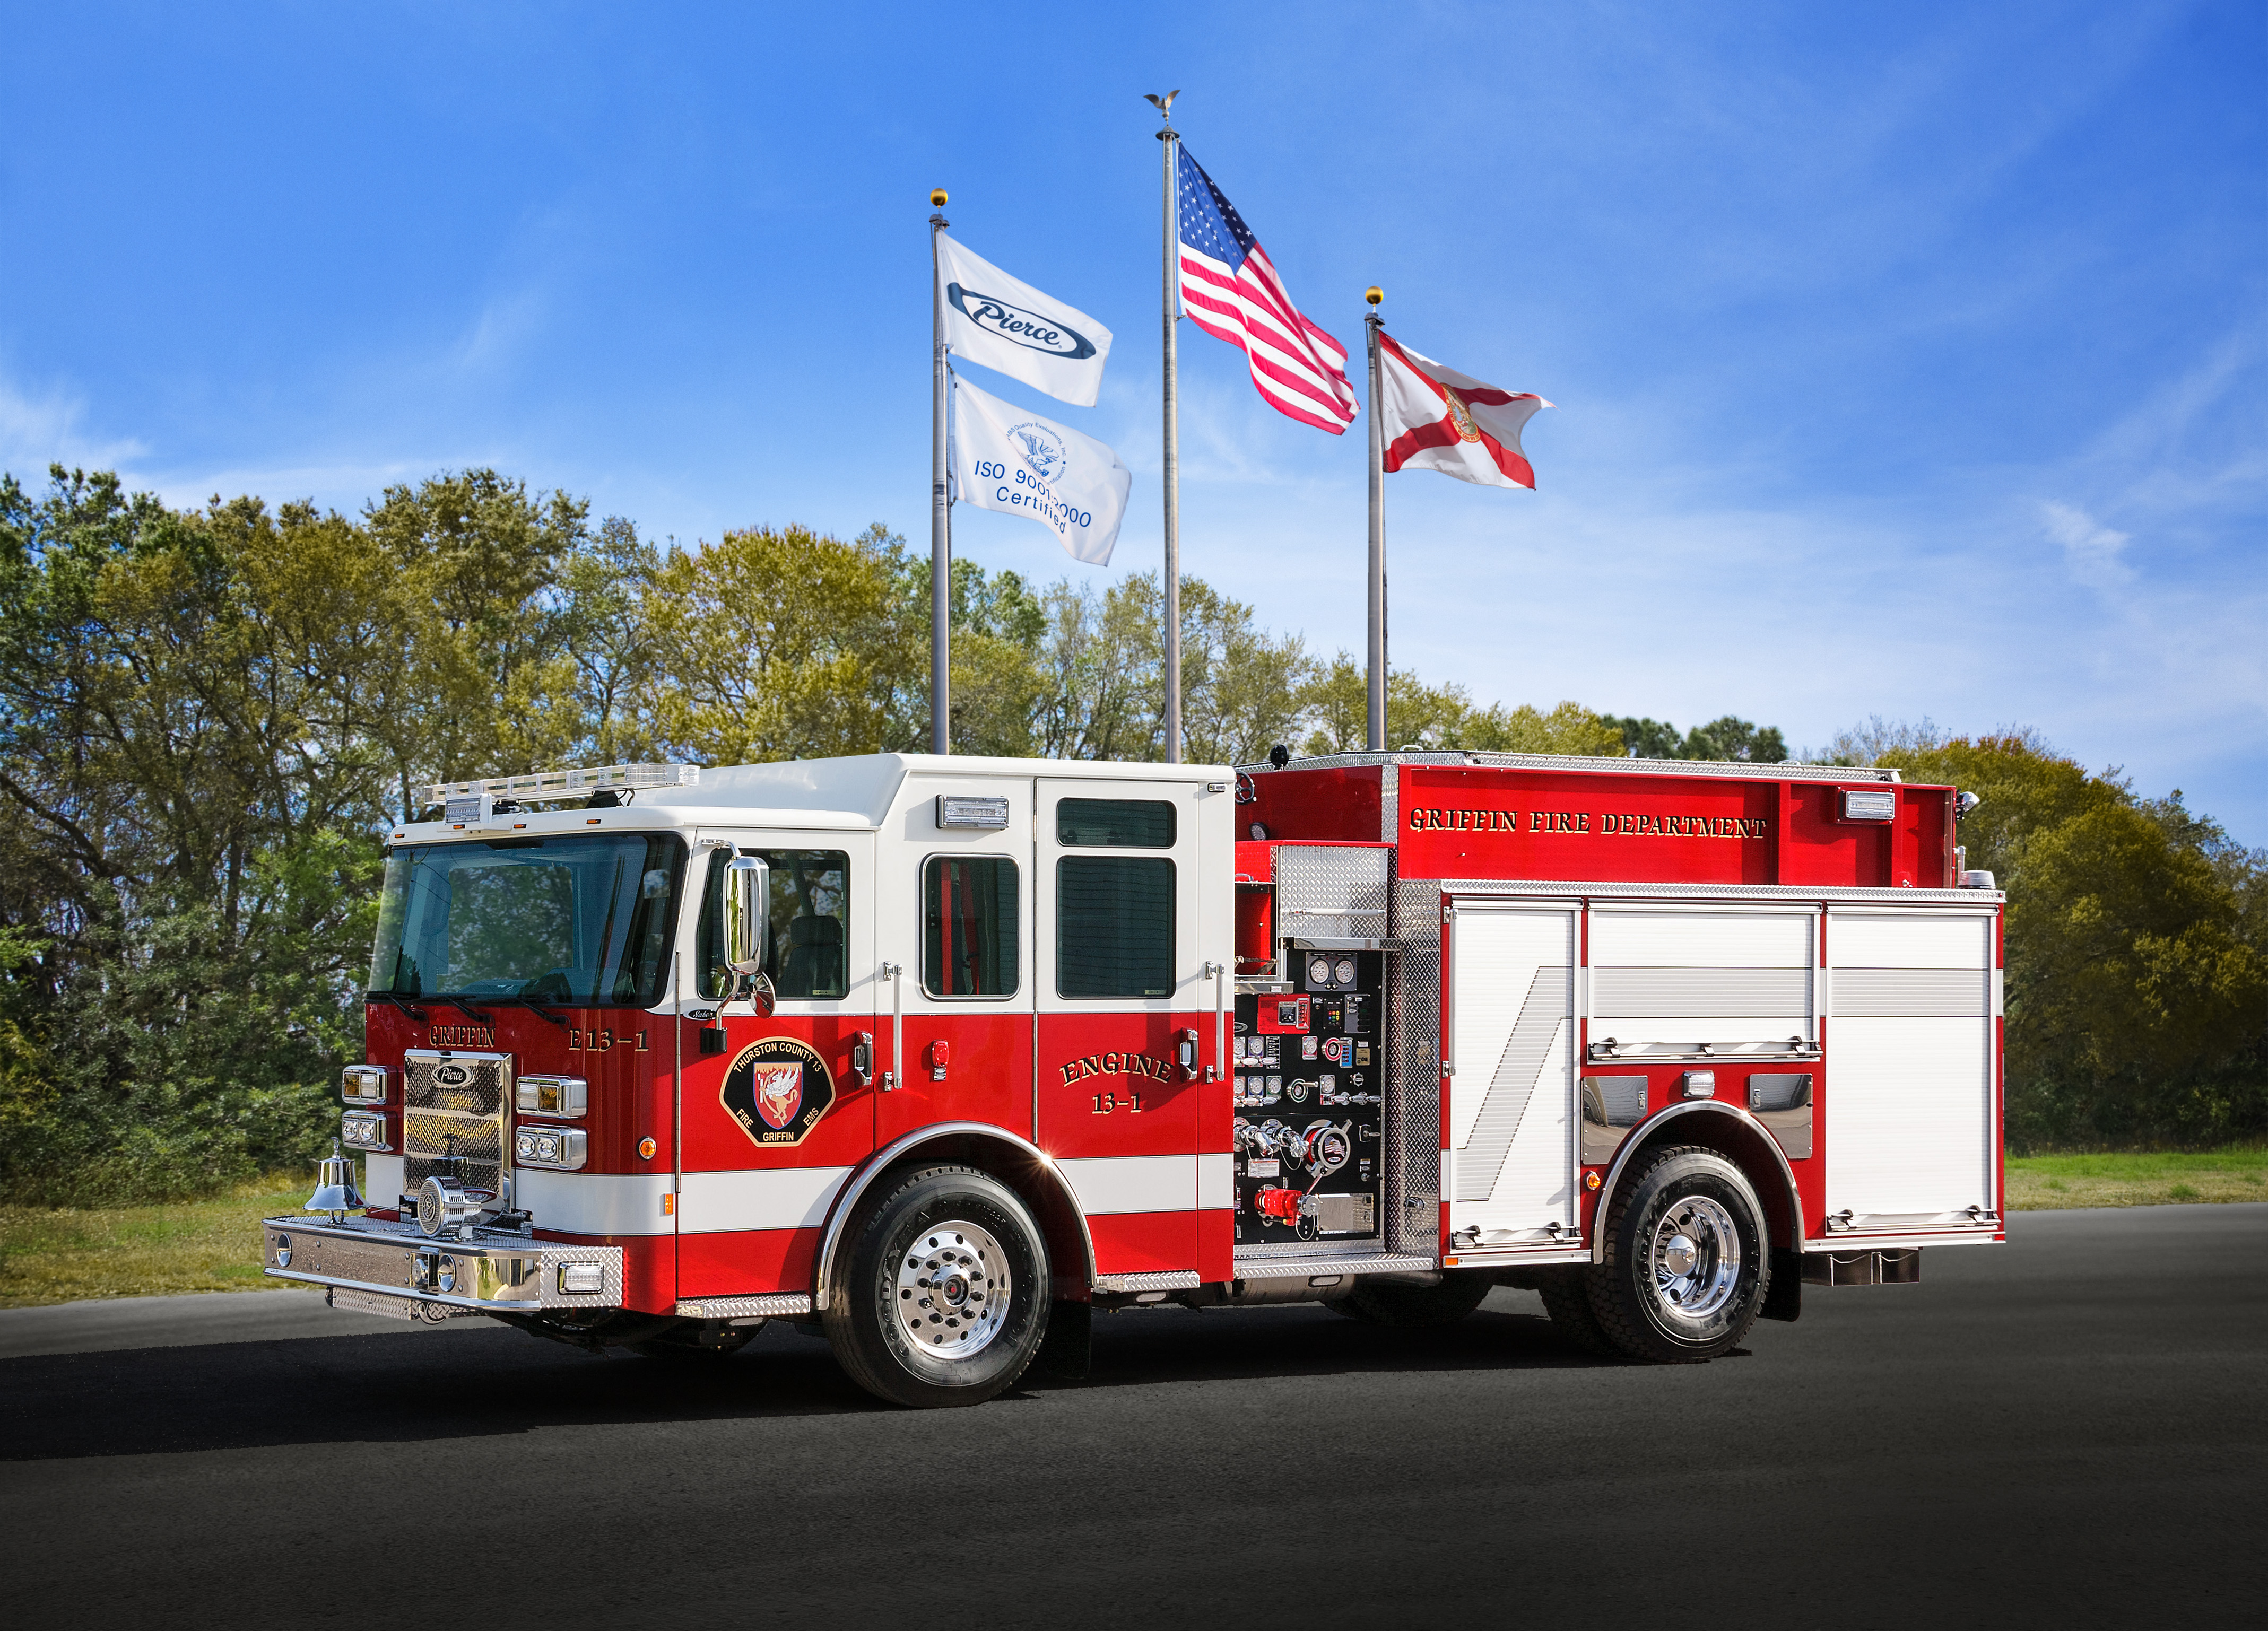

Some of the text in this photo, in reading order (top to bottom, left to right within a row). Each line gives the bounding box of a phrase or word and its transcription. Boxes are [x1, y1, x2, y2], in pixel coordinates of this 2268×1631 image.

[973, 301, 1061, 345] Pierce
[1014, 422, 1033, 430] Quality
[975, 460, 1005, 479] ISO
[996, 486, 1066, 534] Certified
[1410, 808, 1768, 839] GRIFFIN FIRE DEPARTMENT
[429, 1025, 496, 1049] GRIFFIN
[734, 1042, 822, 1073] THURSTON COUNTY 13
[441, 1067, 463, 1081] Pierce
[1059, 1052, 1174, 1087] ENGINE
[1092, 1092, 1142, 1114] 13-1
[736, 1109, 754, 1129] FIRE
[803, 1107, 819, 1127] EMS
[762, 1131, 794, 1141] GRIFFIN
